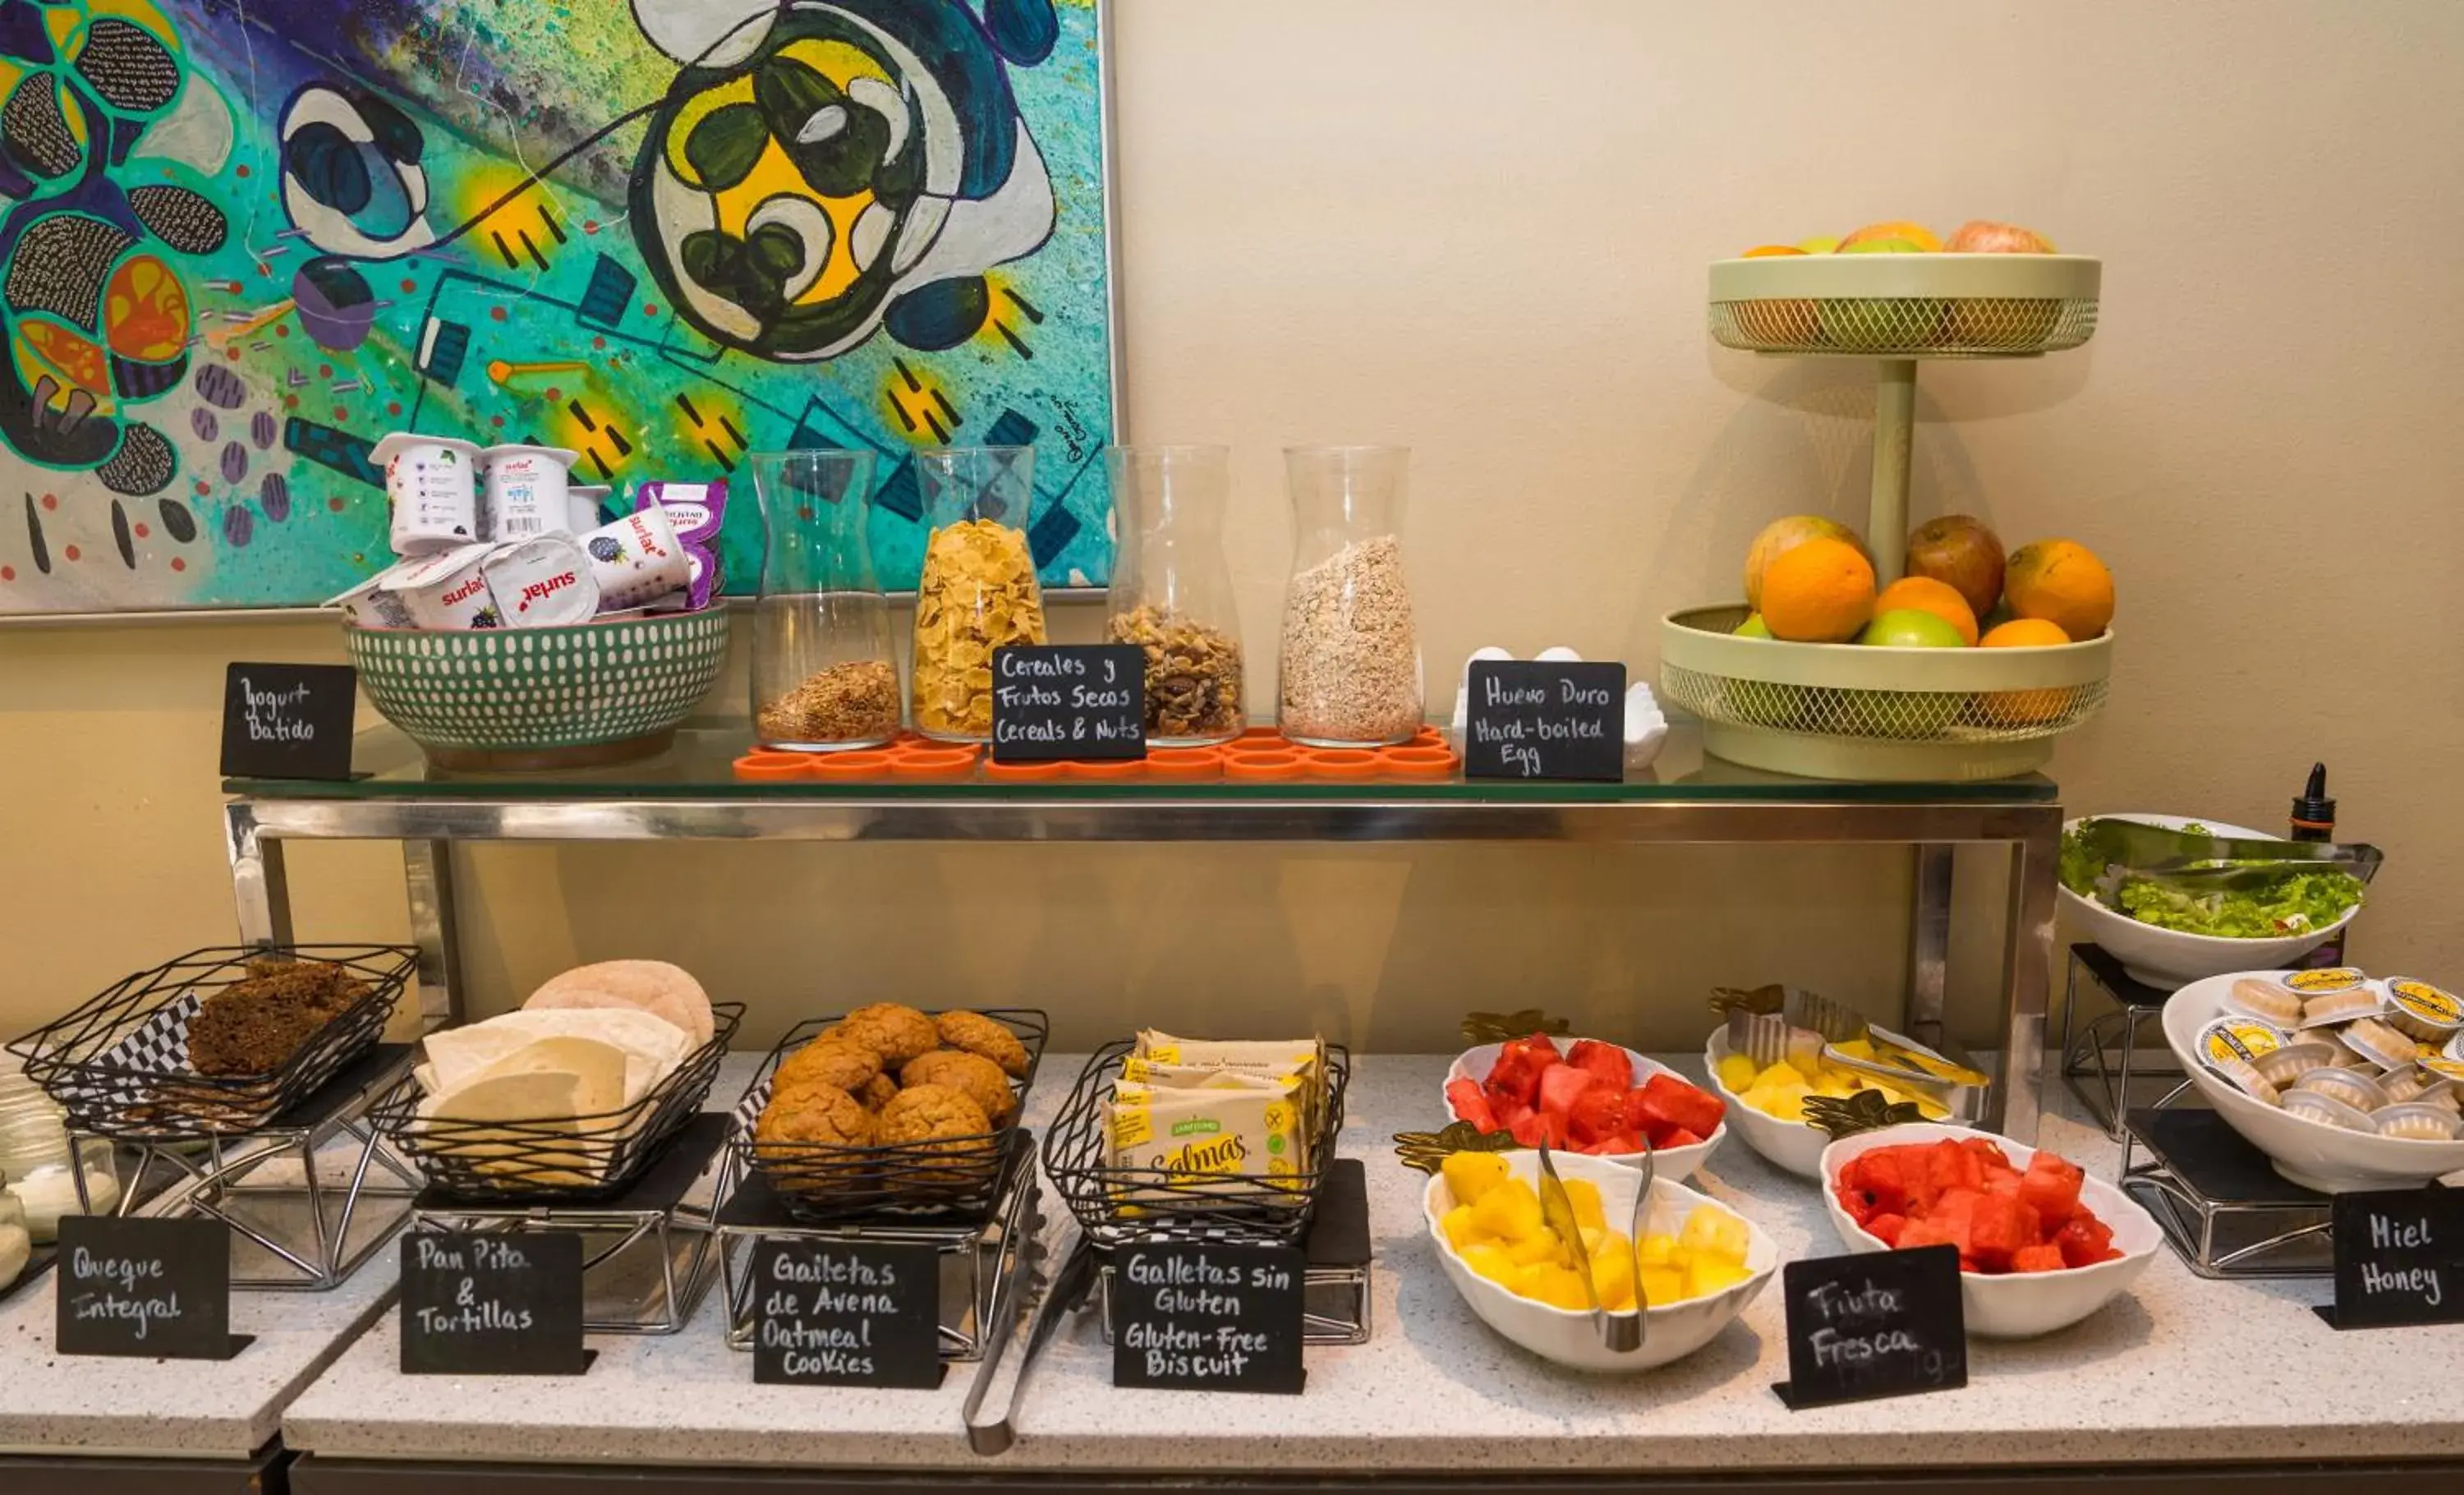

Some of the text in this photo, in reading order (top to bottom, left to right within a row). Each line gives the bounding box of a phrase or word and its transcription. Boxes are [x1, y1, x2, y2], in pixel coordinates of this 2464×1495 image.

[628, 515, 657, 554] surlat
[522, 571, 577, 602] surlat
[1001, 652, 1116, 683] Cereales y
[996, 684, 1130, 708] Frutos Secos
[1485, 675, 1610, 706] Huevo Duro
[247, 717, 315, 741] Batido
[996, 714, 1140, 743] Cereals & Nuts
[1474, 715, 1604, 743] Hard-boiled
[1501, 743, 1542, 777] Egg
[2370, 1213, 2433, 1249] Miel
[72, 1246, 164, 1292] Queque
[417, 1238, 532, 1270] Pan Pita
[1127, 1253, 1290, 1290] Galletas sin
[2361, 1262, 2442, 1306] Honey
[456, 1276, 475, 1306] &
[765, 1286, 899, 1315] de Avena
[1154, 1287, 1241, 1315] Gluten
[71, 1290, 182, 1340] Integral
[416, 1299, 533, 1334] Tortillas
[762, 1317, 872, 1350] Oatmeal
[1809, 1327, 1922, 1368] Fresca
[1145, 1349, 1249, 1378] Biscuit
